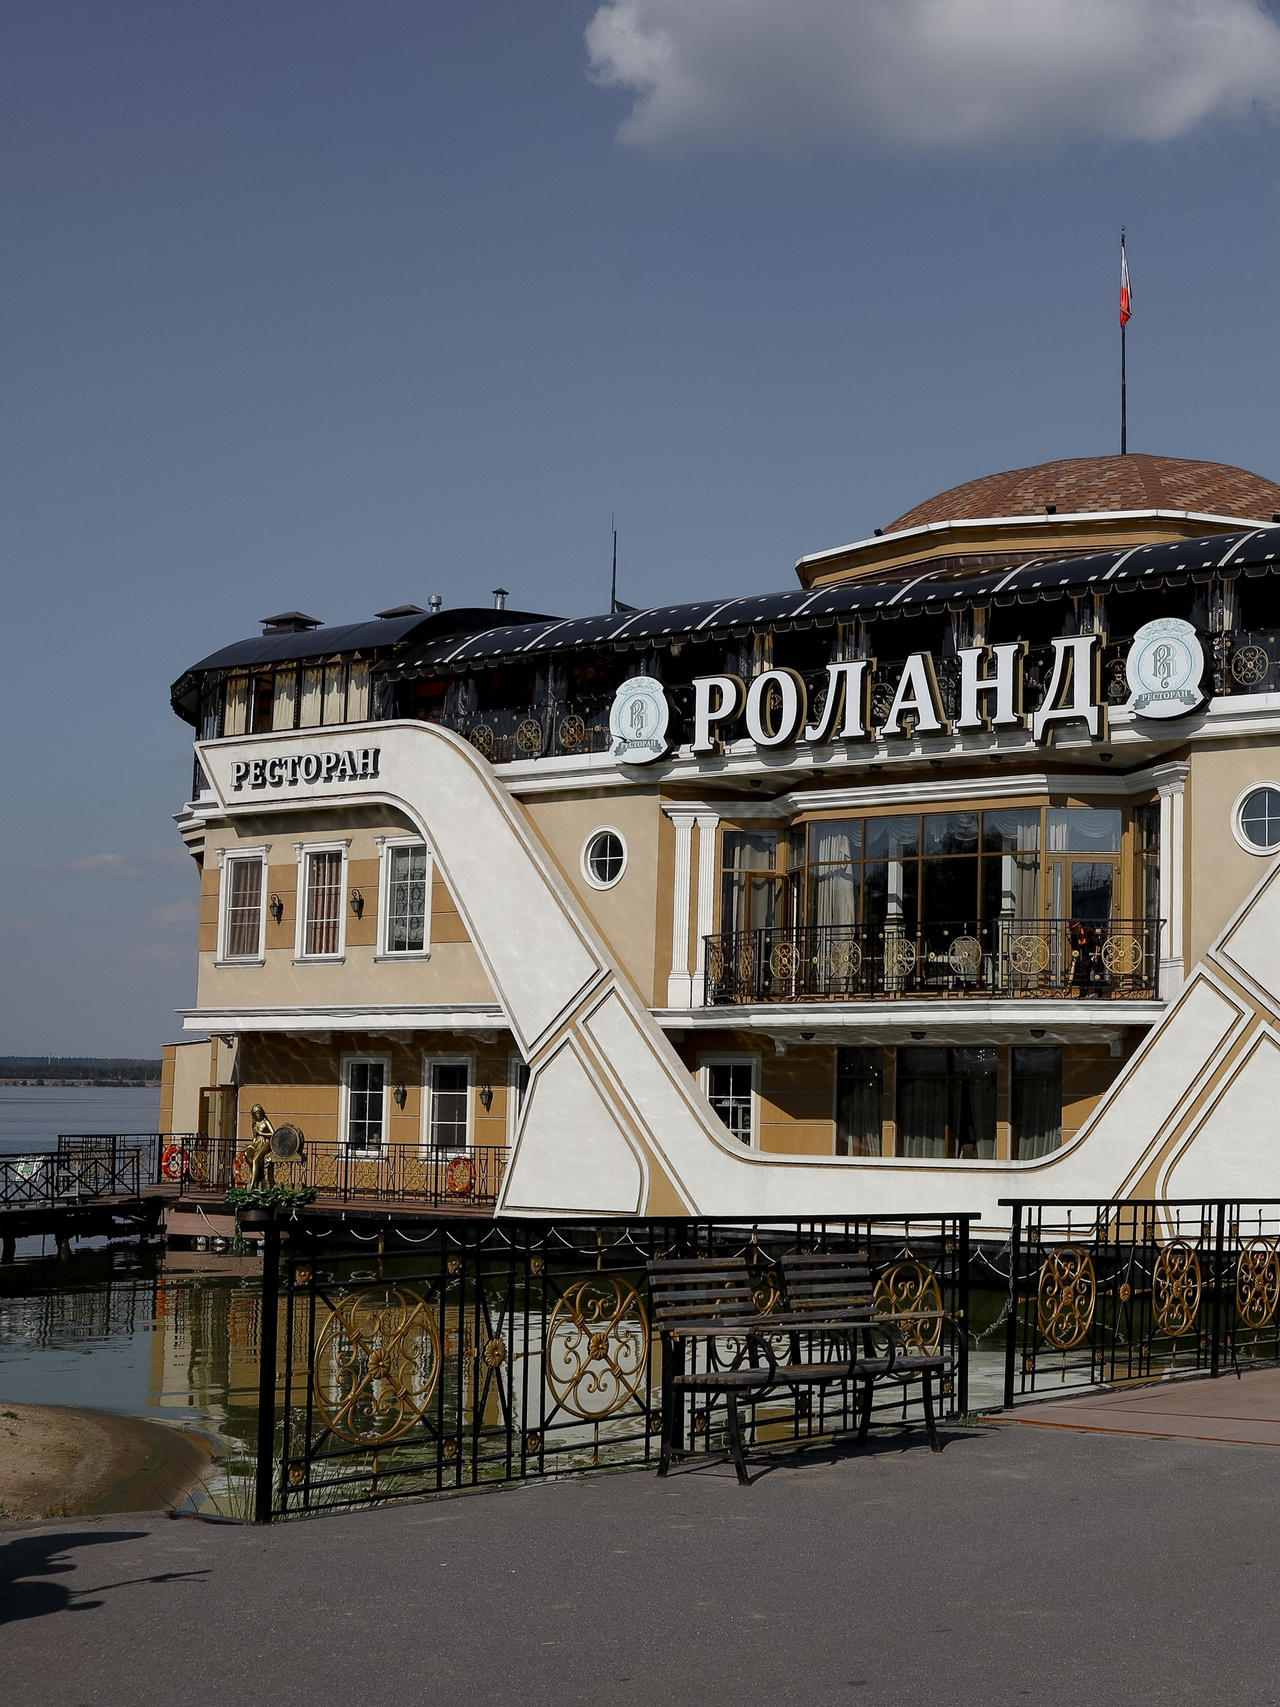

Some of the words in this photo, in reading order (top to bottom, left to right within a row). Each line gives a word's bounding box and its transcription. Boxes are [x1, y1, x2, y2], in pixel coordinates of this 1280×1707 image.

[691, 632, 1107, 756] РОЛАНД
[1142, 691, 1188, 701] РЕСТОРАН
[230, 747, 381, 791] РЕСТОРАН
